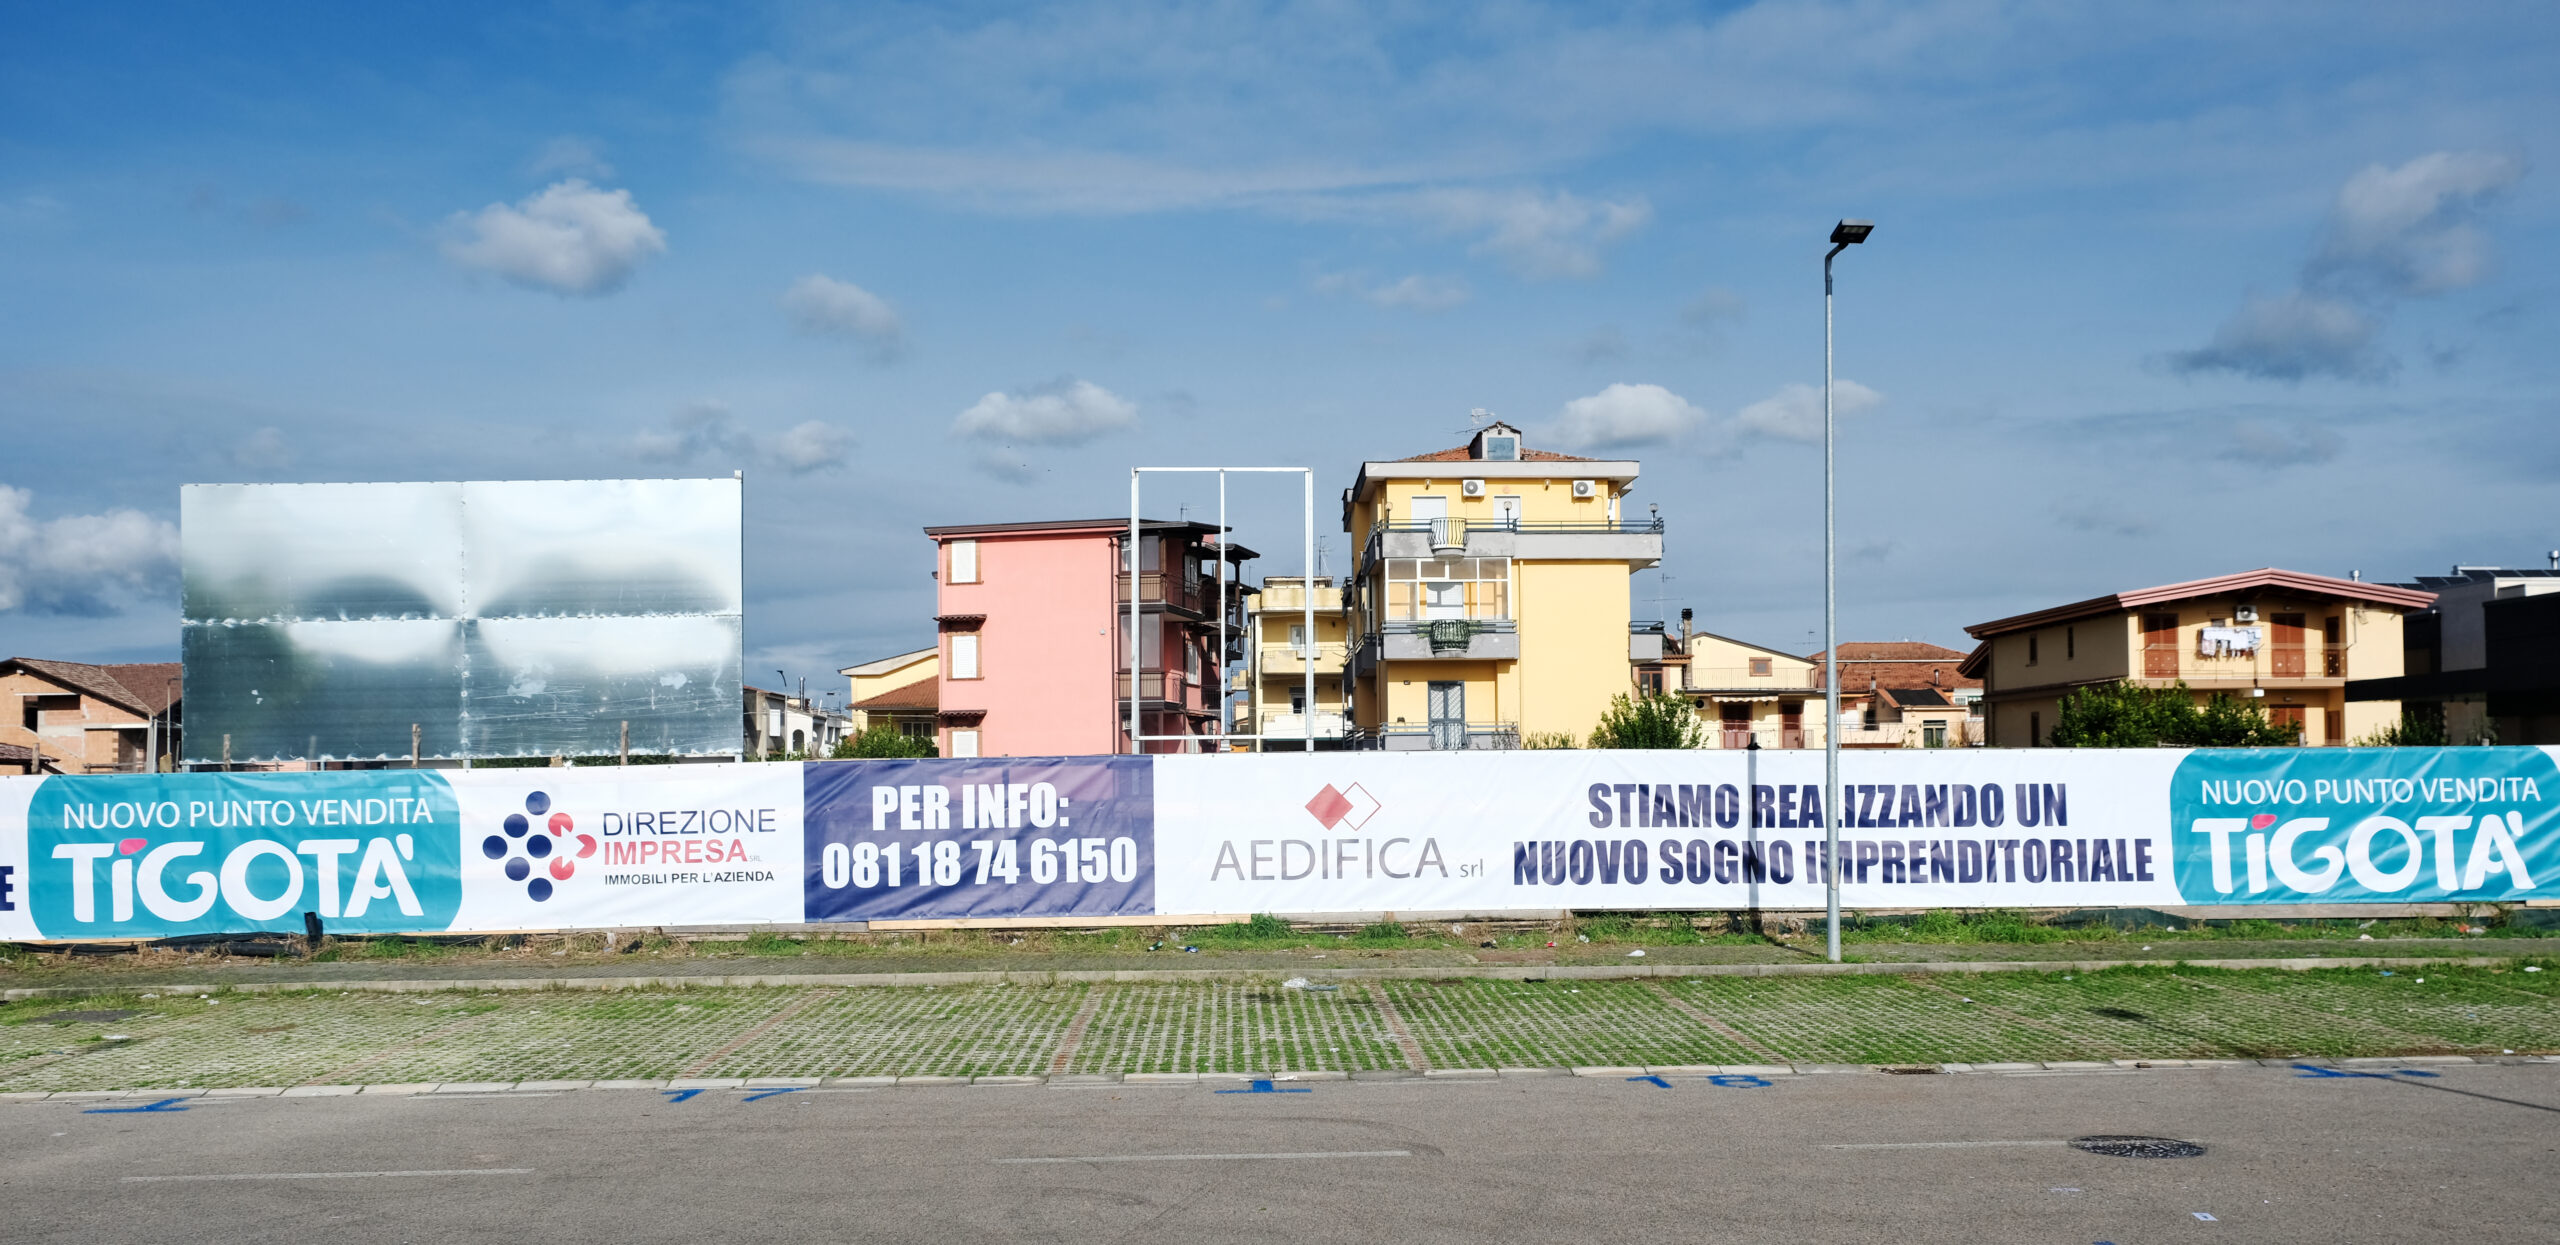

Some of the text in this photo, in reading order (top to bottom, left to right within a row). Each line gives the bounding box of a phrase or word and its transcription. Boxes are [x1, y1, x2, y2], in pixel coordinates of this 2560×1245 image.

[872, 782, 1069, 831] PER INFO:
[1588, 783, 1740, 829] STIAMO
[2015, 783, 2068, 827] UN
[2201, 777, 2541, 805] NUOVO PUNTO VENDITA
[64, 798, 434, 829] NUOVO PUNTO VENDITA
[603, 809, 776, 836] DIREZIONE
[604, 839, 747, 865] IMPRESA
[822, 837, 1137, 889] 081 18 74 6150
[1210, 837, 1484, 881] AEDIFICA srl
[1513, 839, 1648, 885] NUOVO
[1659, 839, 1794, 885] SOGNO
[604, 871, 774, 885] IMMOBILI PER L'AZIENDA
